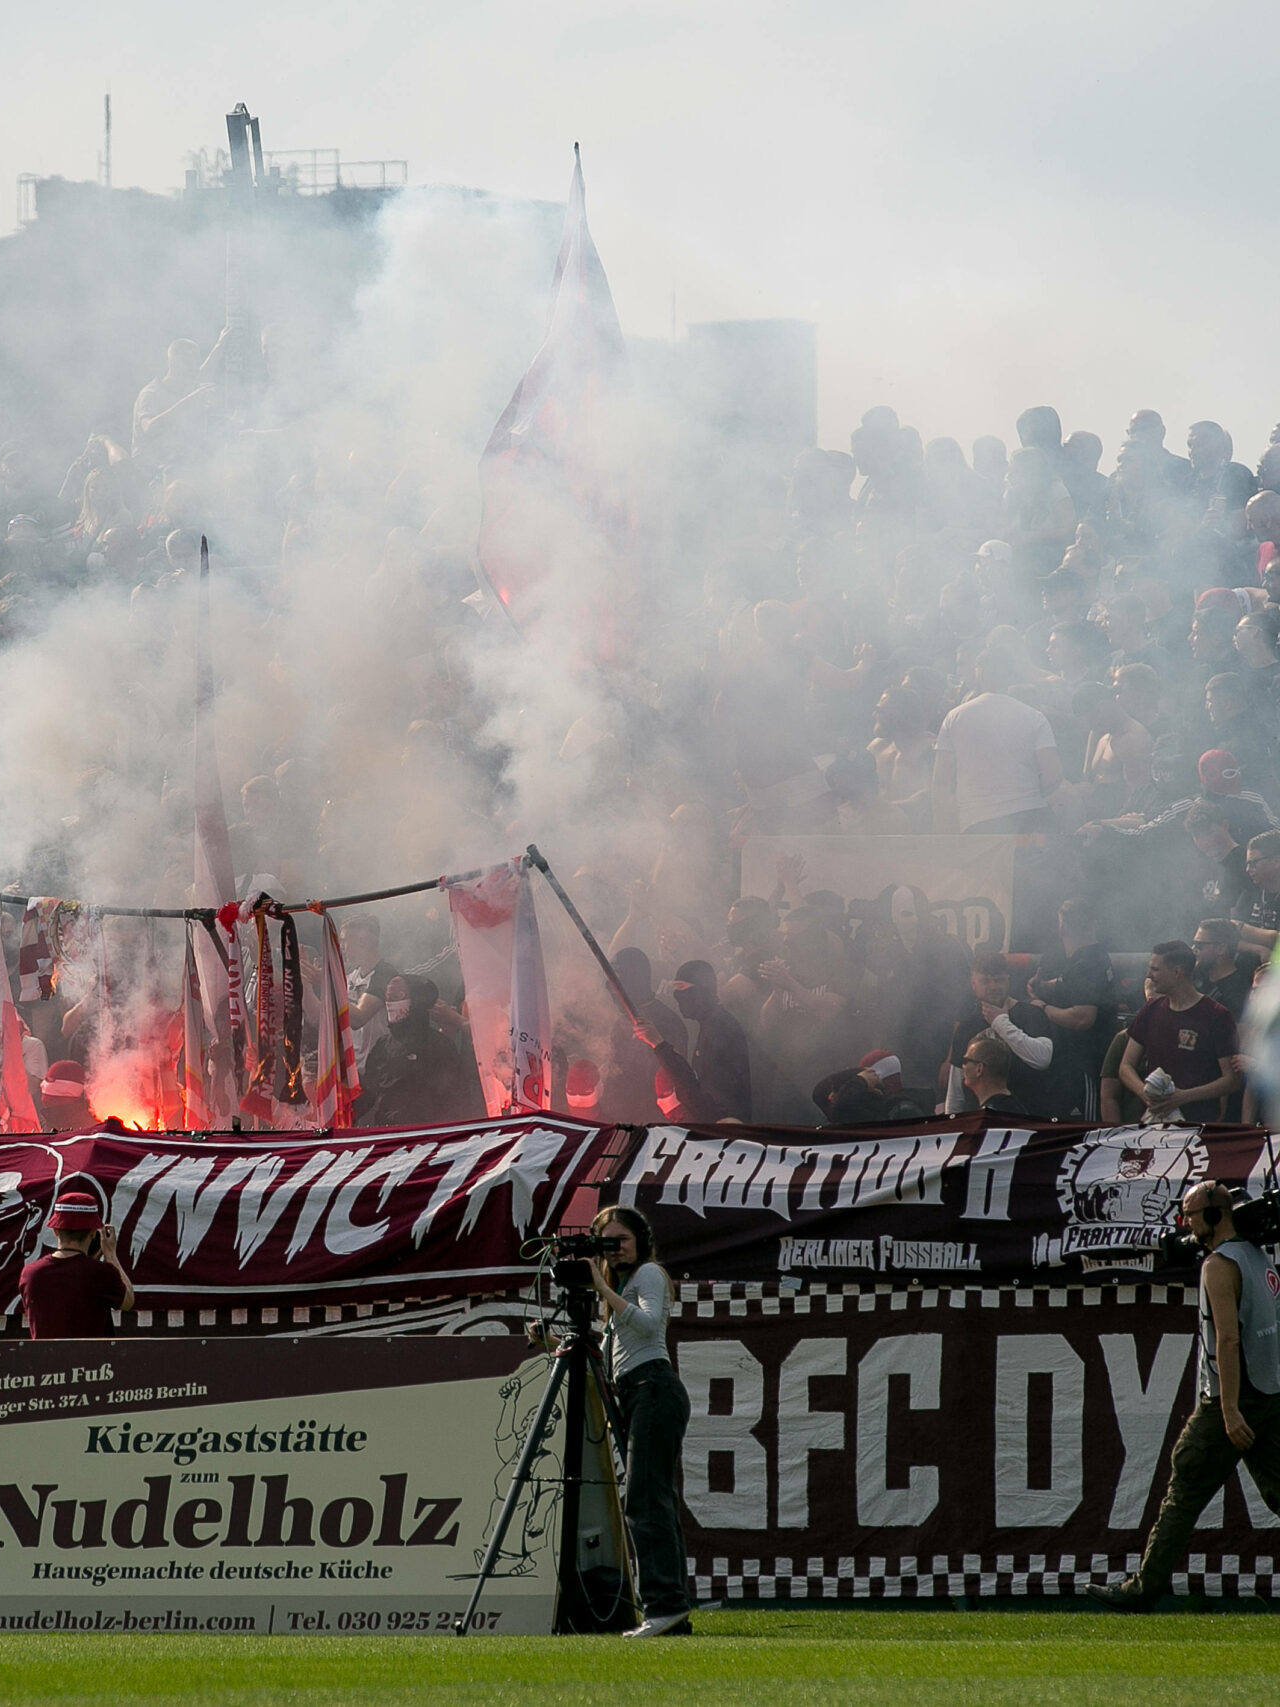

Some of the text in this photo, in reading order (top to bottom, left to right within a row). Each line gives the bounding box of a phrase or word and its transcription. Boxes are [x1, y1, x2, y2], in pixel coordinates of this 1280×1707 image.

[122, 1128, 569, 1270] INVICTA
[778, 1234, 982, 1271] BERLINER FUSSBALL
[39, 1373, 68, 1390] zu
[72, 1363, 115, 1385] Fuß
[28, 1396, 56, 1413] Str.
[58, 1393, 90, 1410] 37A
[106, 1387, 155, 1406] 13088
[157, 1381, 208, 1401] Berlin
[85, 1420, 368, 1466] Kiezgaststätte
[677, 1333, 943, 1530] BFC
[179, 1470, 220, 1485] zum
[31, 1558, 394, 1587] Hausgemachte deutsche Küche
[287, 1610, 329, 1631] Tel.
[337, 1611, 383, 1631] 030
[387, 1611, 432, 1630] 925
